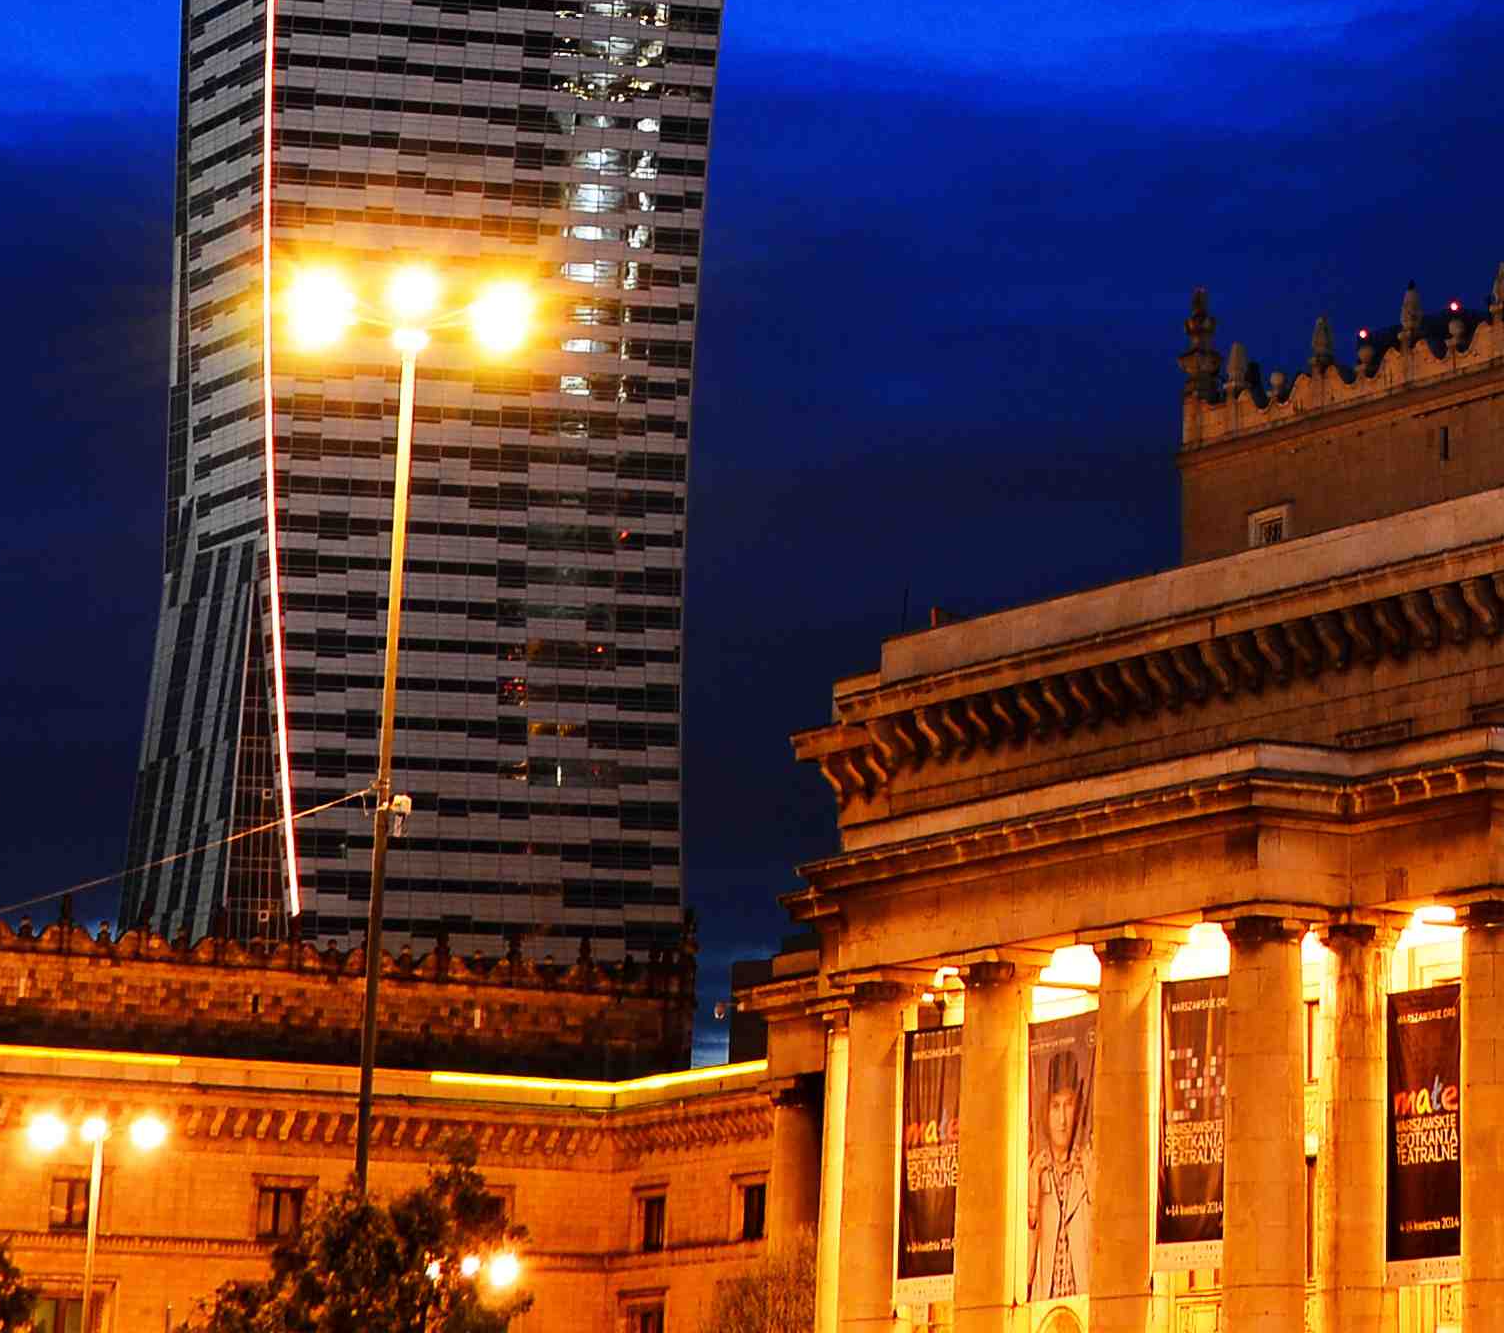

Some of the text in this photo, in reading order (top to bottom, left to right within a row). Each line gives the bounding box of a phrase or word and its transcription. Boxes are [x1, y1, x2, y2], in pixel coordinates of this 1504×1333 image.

[1165, 1133, 1224, 1150] SPOTKANIA
[1397, 1129, 1458, 1149] SPOTKANIA
[1165, 1148, 1223, 1167] TEATRALNE
[1397, 1145, 1458, 1166] TEATRALNE
[907, 1171, 959, 1190] TEATRALNE
[1441, 1216, 1459, 1230] 2014
